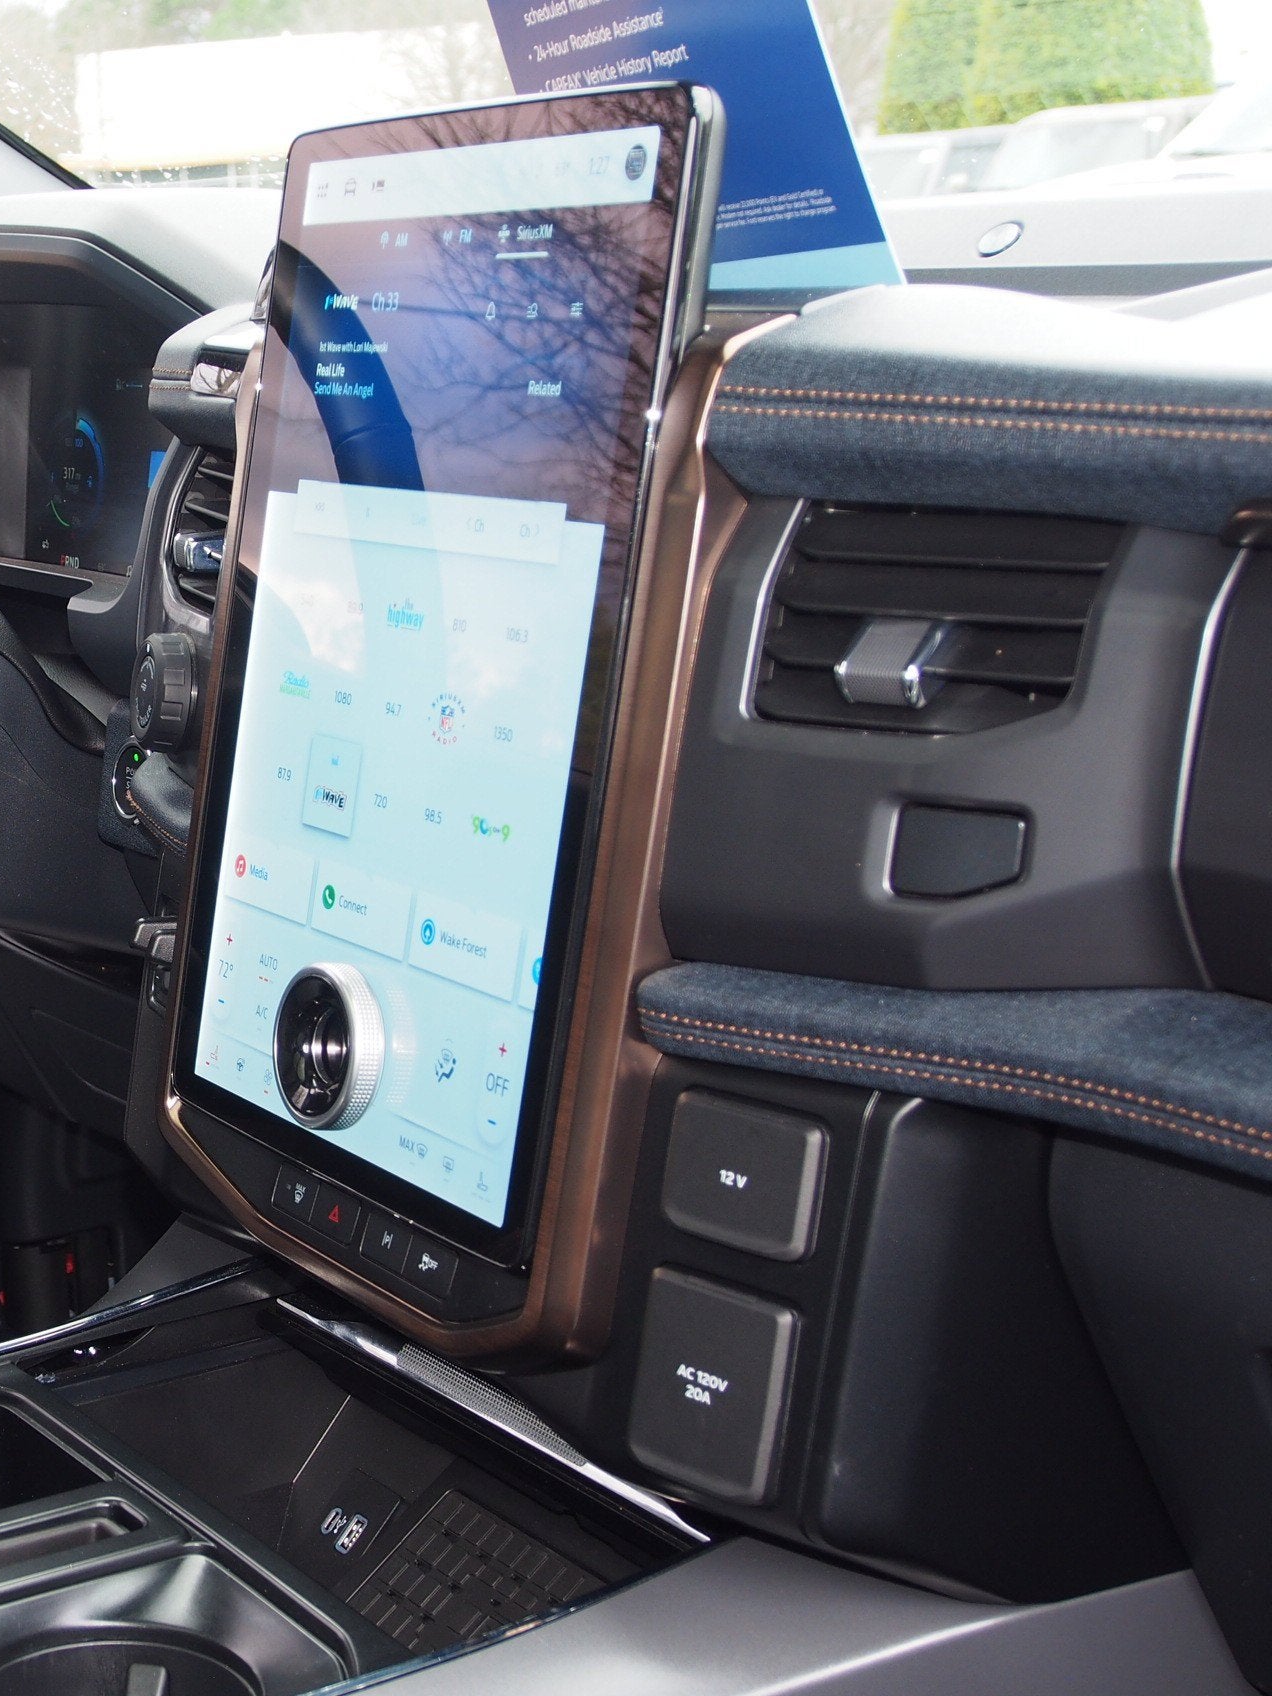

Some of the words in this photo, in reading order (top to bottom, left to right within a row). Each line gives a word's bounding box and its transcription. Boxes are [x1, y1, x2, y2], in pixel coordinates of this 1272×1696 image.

[524, 0, 568, 27] scheduled
[534, 38, 570, 62] 24-Hour
[569, 24, 613, 51] Roadside
[582, 63, 618, 86] Vehicle
[616, 55, 652, 77] History
[651, 43, 690, 69] Report
[395, 231, 409, 248] AM
[459, 228, 472, 243] FM
[516, 223, 554, 241] SiriusXM
[371, 292, 385, 311] Ch
[386, 291, 399, 311] 33
[316, 362, 332, 378] Real
[331, 362, 346, 378] Life
[314, 381, 332, 396] Send
[331, 381, 343, 396] Me
[342, 382, 353, 397] An
[352, 382, 374, 400] Angel
[527, 379, 562, 397] Related
[387, 603, 425, 631] highway
[334, 690, 352, 706] 1080
[385, 701, 402, 717] 94.7
[277, 766, 292, 782] 87.9
[374, 793, 388, 809] 720
[424, 807, 442, 825] 98.5
[338, 894, 367, 916] Connect
[440, 929, 461, 949] Wake
[461, 937, 487, 959] Forest
[259, 953, 278, 971] AUTO
[256, 1004, 269, 1020] A/C
[486, 1072, 510, 1097] OFF
[398, 1134, 416, 1154] MAX
[719, 1169, 735, 1186] 12
[735, 1173, 748, 1189] V
[676, 1363, 696, 1381] AC
[696, 1370, 729, 1392] 120V
[684, 1383, 711, 1406] 20A
